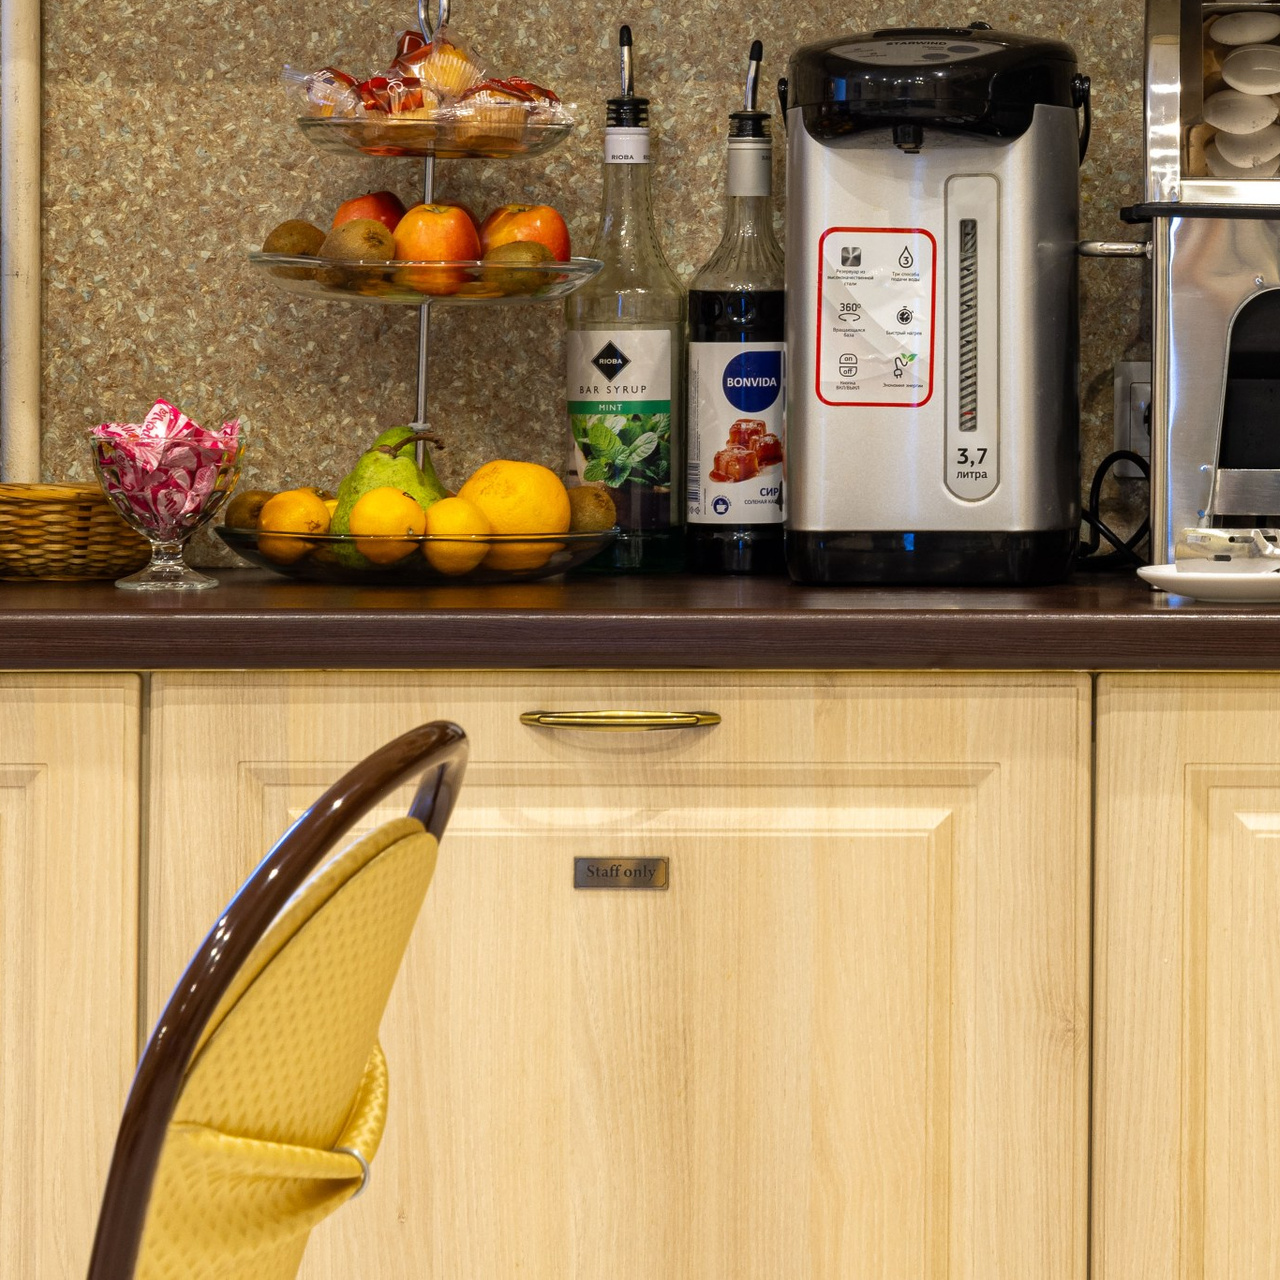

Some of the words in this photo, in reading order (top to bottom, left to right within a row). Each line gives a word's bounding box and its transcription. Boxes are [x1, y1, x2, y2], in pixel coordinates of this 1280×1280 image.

[903, 257, 909, 265] 3
[727, 377, 777, 387] BONVIDA
[579, 386, 599, 394] BAR
[606, 385, 647, 394] SYRUP
[957, 448, 988, 467] 3,7
[956, 471, 988, 480] литра
[586, 864, 622, 877] Staff
[624, 865, 656, 880] only
